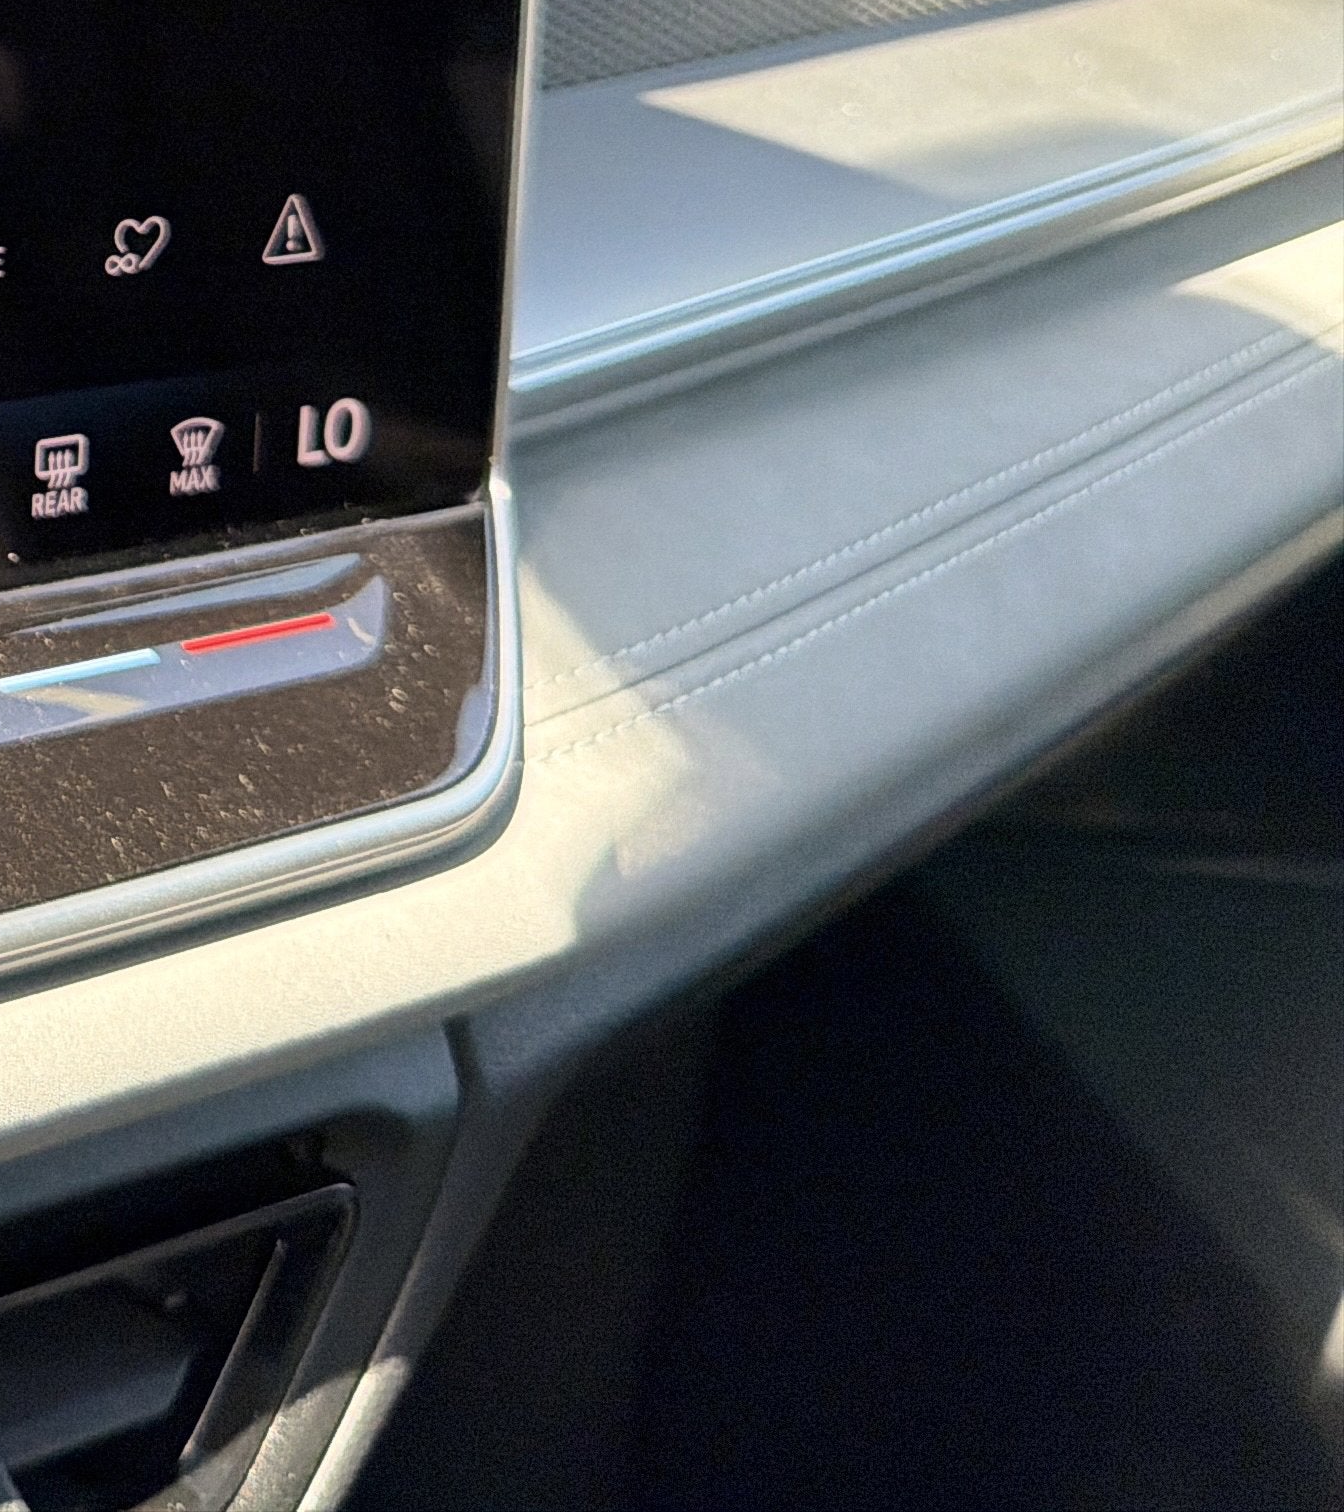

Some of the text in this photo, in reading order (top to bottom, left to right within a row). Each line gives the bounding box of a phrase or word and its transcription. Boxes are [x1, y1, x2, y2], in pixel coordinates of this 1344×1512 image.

[297, 397, 370, 467] LO
[169, 464, 219, 496] MAX
[30, 486, 88, 518] REAR
